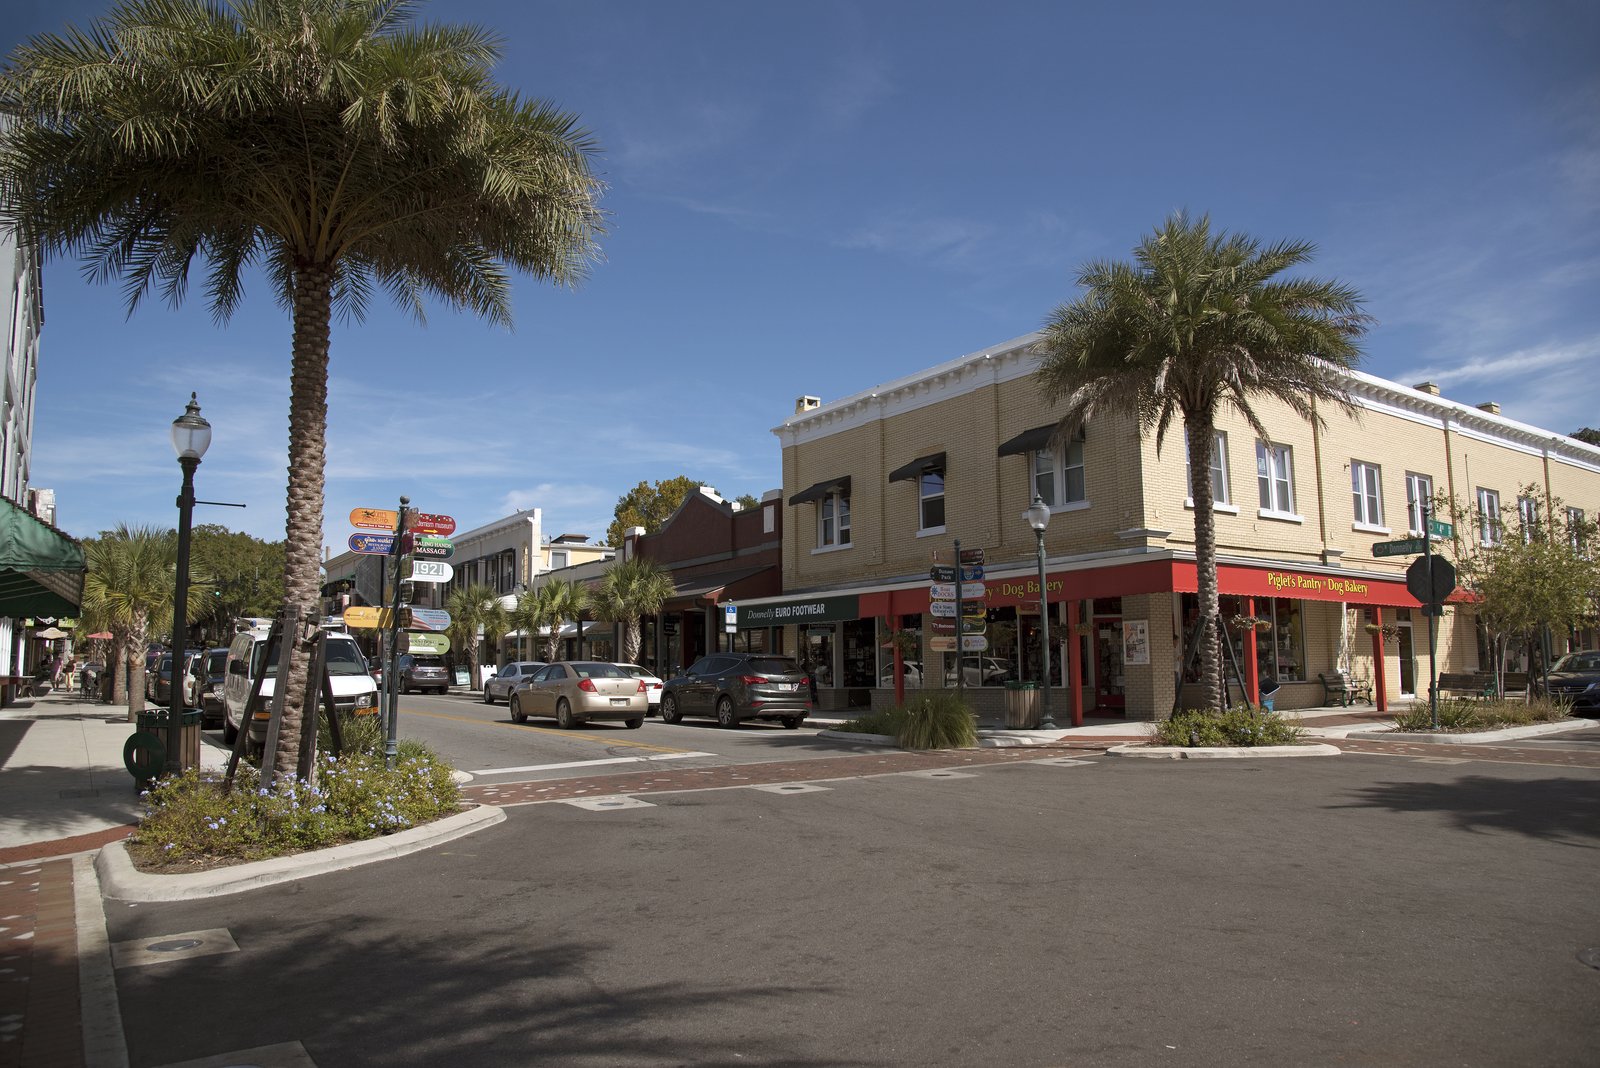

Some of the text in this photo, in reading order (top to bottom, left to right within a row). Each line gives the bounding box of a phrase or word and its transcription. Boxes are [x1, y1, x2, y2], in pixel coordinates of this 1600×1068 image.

[435, 522, 453, 530] museum
[416, 547, 447, 555] MASSAGE
[1389, 543, 1412, 553] Donnelly
[414, 562, 444, 576] 1921
[1002, 583, 1024, 598] Dog
[1027, 580, 1064, 594] Baery
[1268, 572, 1368, 597] Piglet's Pantry Dog Bakery
[747, 609, 775, 620] Donnelly
[775, 606, 791, 618] EURO
[792, 603, 825, 617] FOOTWEAR
